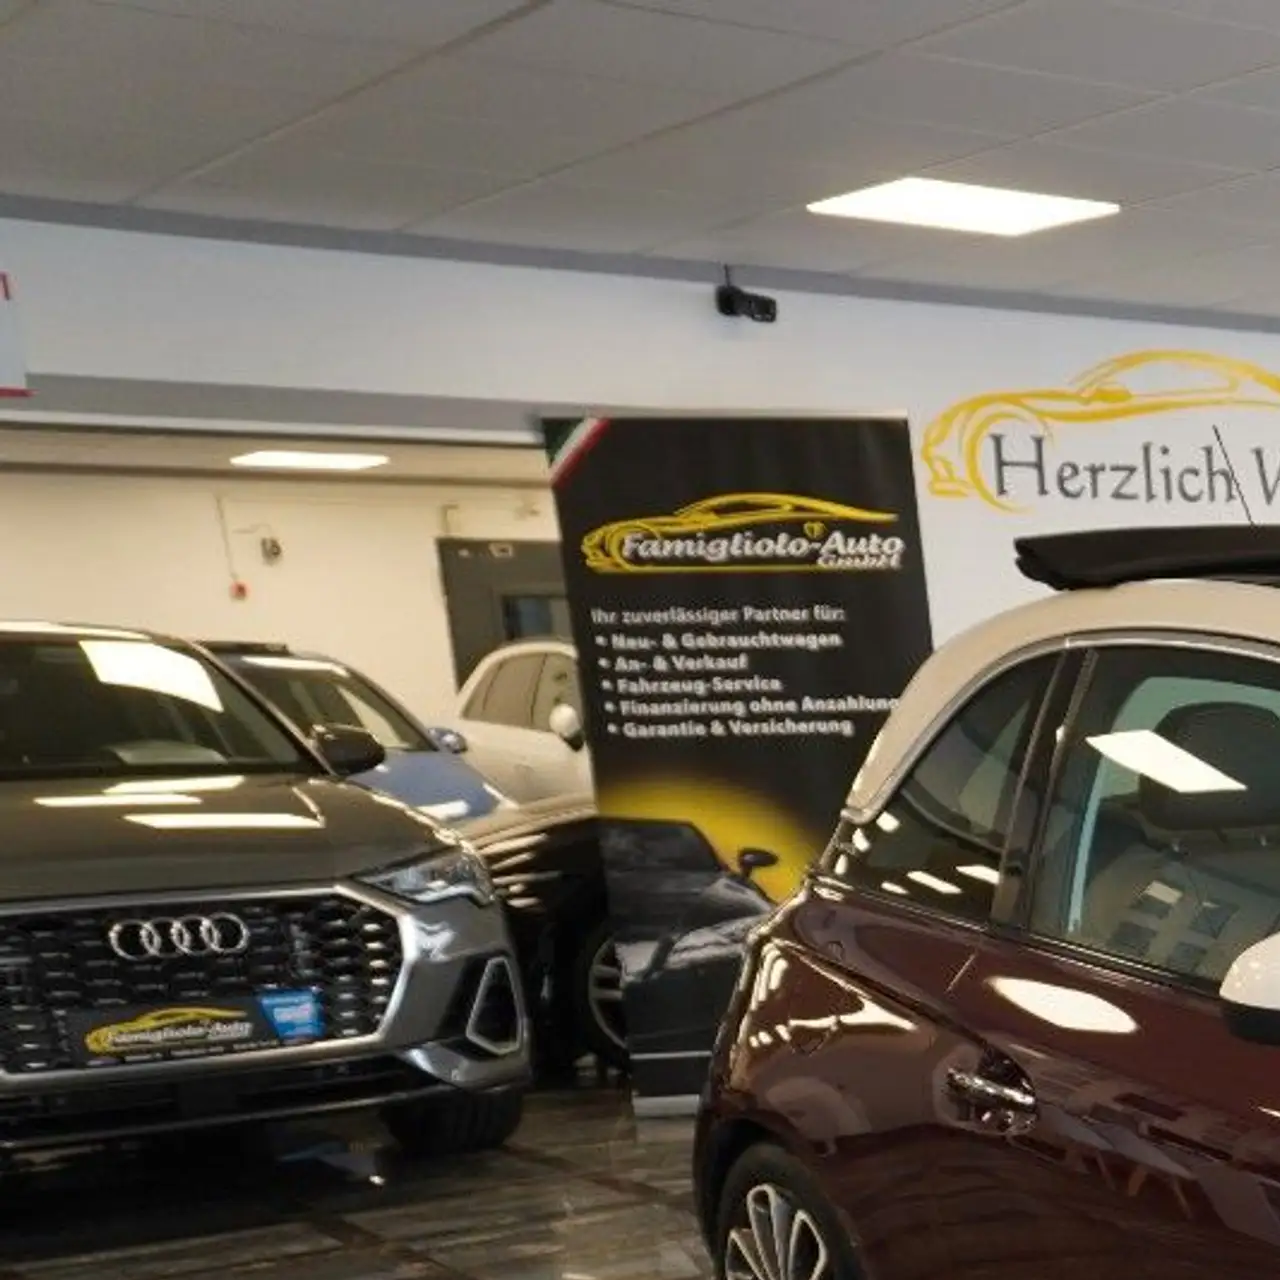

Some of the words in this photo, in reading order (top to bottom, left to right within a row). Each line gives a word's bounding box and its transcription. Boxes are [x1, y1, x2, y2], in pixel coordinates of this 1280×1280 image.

[990, 432, 1234, 504] Herzlich
[621, 606, 738, 625] zuverlässiger
[743, 605, 809, 622] Partner
[813, 604, 846, 621] für:
[661, 633, 679, 649] &
[680, 630, 843, 651] Gebrauchtwagen
[614, 656, 648, 672] An-
[652, 656, 669, 671] &
[671, 653, 749, 670] Verkauf
[617, 676, 783, 696] Fahrzeug-Service
[620, 699, 746, 717] Finanzierung
[749, 698, 797, 713] ohne
[622, 721, 707, 738] Garantie
[710, 720, 727, 736] &
[729, 718, 854, 737] Versicherung
